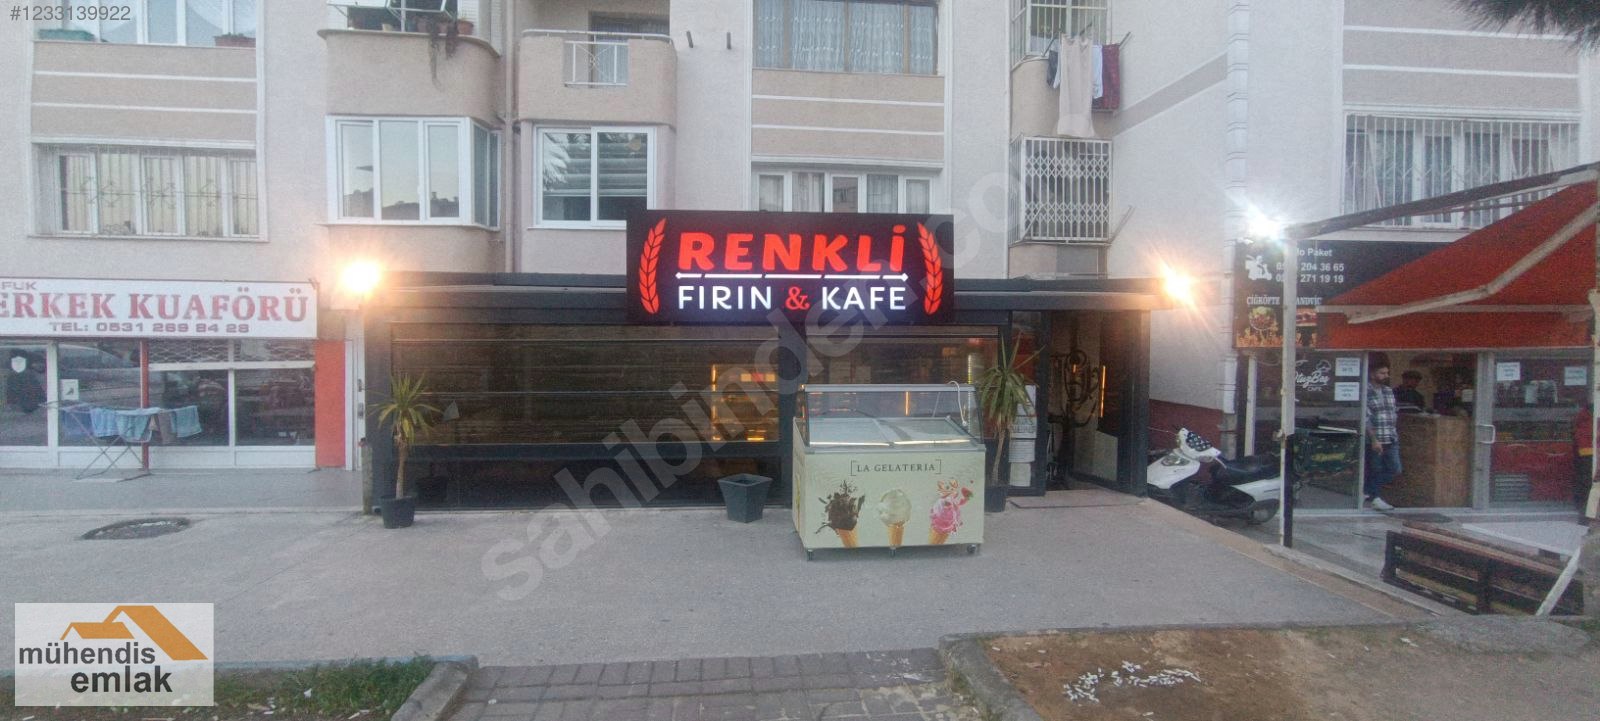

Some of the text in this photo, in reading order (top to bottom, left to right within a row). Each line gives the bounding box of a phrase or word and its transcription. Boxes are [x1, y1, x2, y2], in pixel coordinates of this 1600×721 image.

[1307, 248, 1333, 257] Paket
[1333, 263, 1345, 272] 65
[1300, 274, 1344, 283] 271 19 19
[677, 285, 906, 310] FIRIN & KAFE
[128, 287, 309, 322] KUAFÖRÜ
[49, 322, 89, 332] TEL:
[96, 322, 144, 332] 0531
[152, 323, 189, 333] 269
[225, 324, 250, 333] 28
[857, 463, 936, 472] LA GELATERIA
